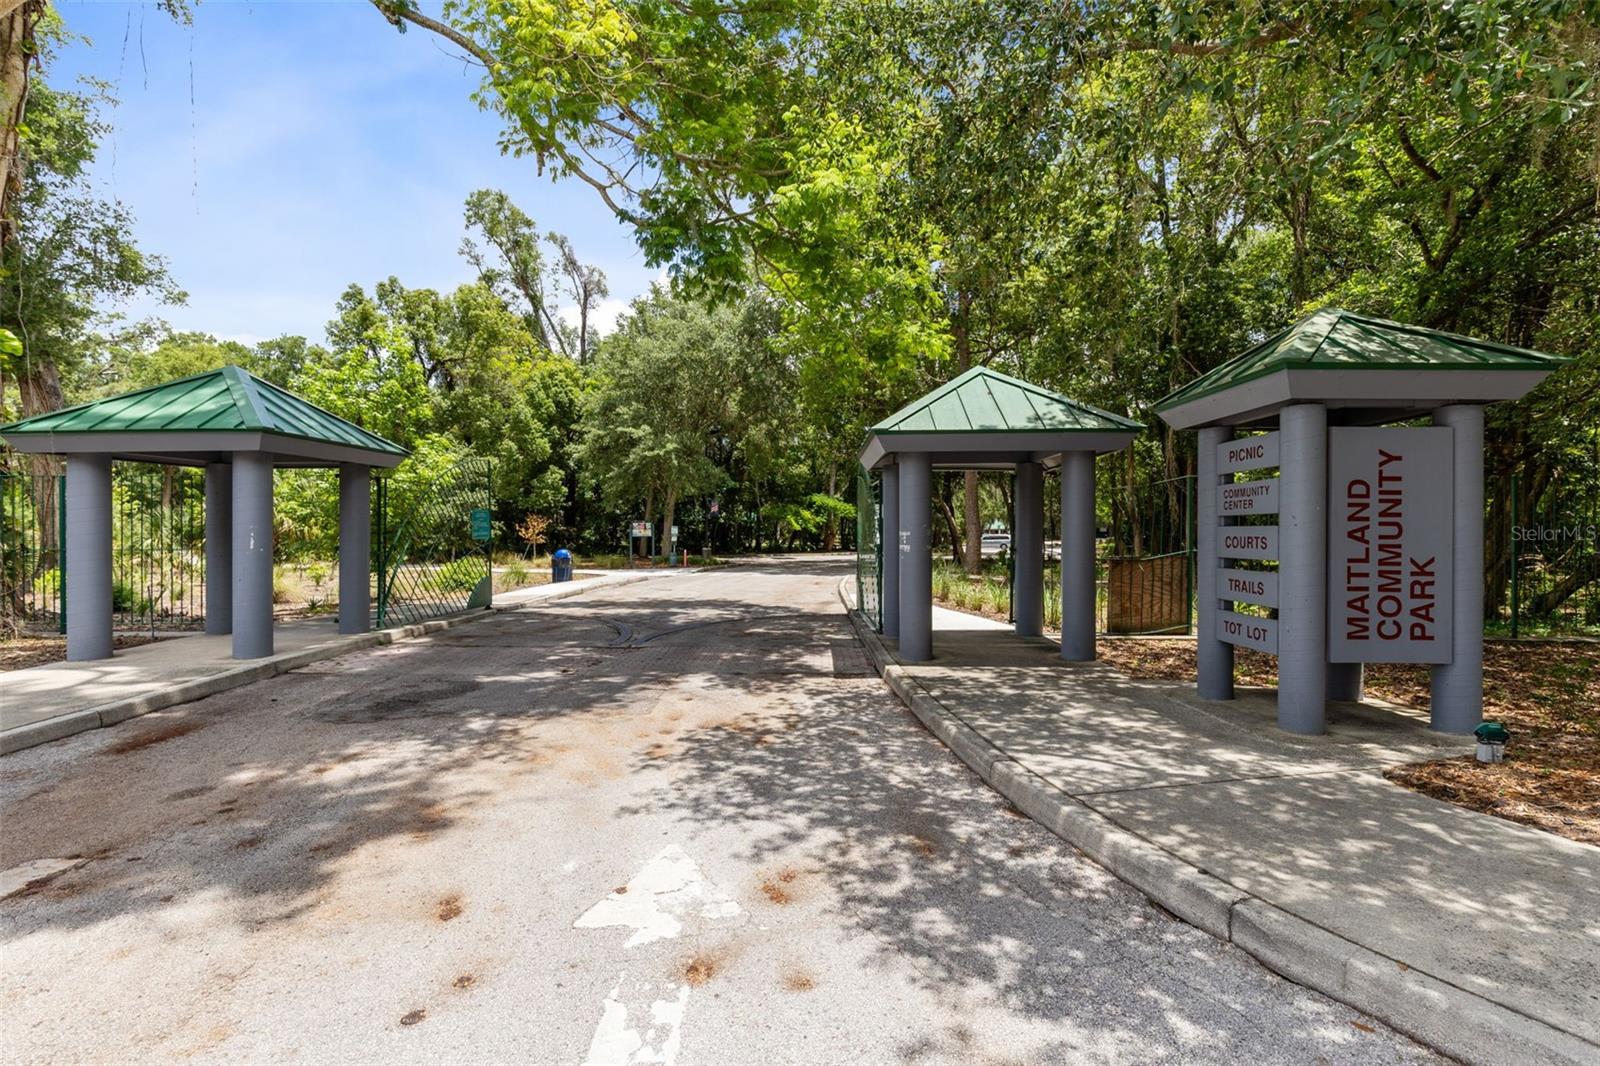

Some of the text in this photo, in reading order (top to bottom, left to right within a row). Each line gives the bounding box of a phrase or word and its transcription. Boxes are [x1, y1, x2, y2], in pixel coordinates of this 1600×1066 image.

[1229, 445, 1264, 463] PICNIC
[1223, 485, 1271, 499] COMMUNITY
[1223, 499, 1254, 511] CENTER
[1225, 535, 1268, 550] COURTS
[1376, 448, 1404, 641] COMMUNITY
[1346, 479, 1371, 641] MAITLAND
[1228, 578, 1265, 596] TRAILS
[1409, 556, 1436, 641] PARK
[1224, 620, 1268, 642] TOT LOT
